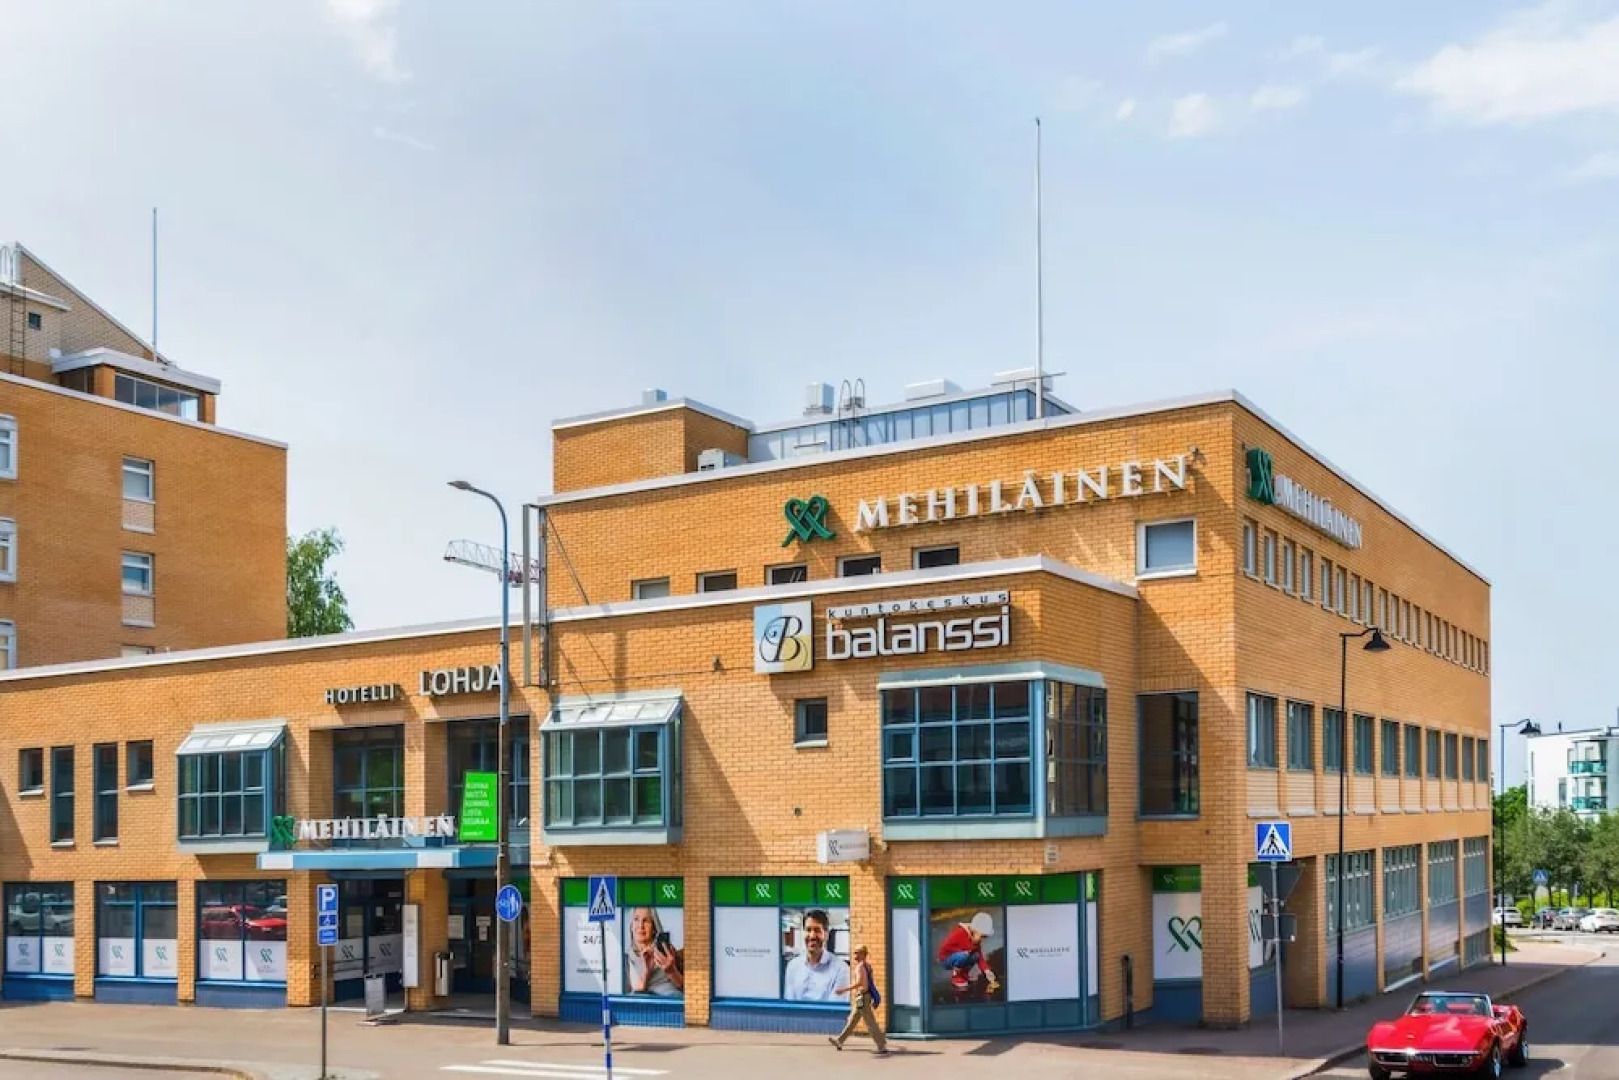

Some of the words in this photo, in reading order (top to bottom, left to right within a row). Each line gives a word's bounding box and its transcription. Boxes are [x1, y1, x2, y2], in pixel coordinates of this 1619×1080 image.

[855, 454, 1188, 531] MEHILÄINEN
[828, 592, 1008, 618] kuntokeskus
[826, 605, 1010, 660] balanssi
[324, 683, 396, 704] HOTELLI
[419, 664, 502, 697] LOHJA
[298, 813, 456, 840] MEHILÄINEN
[321, 888, 336, 911] P
